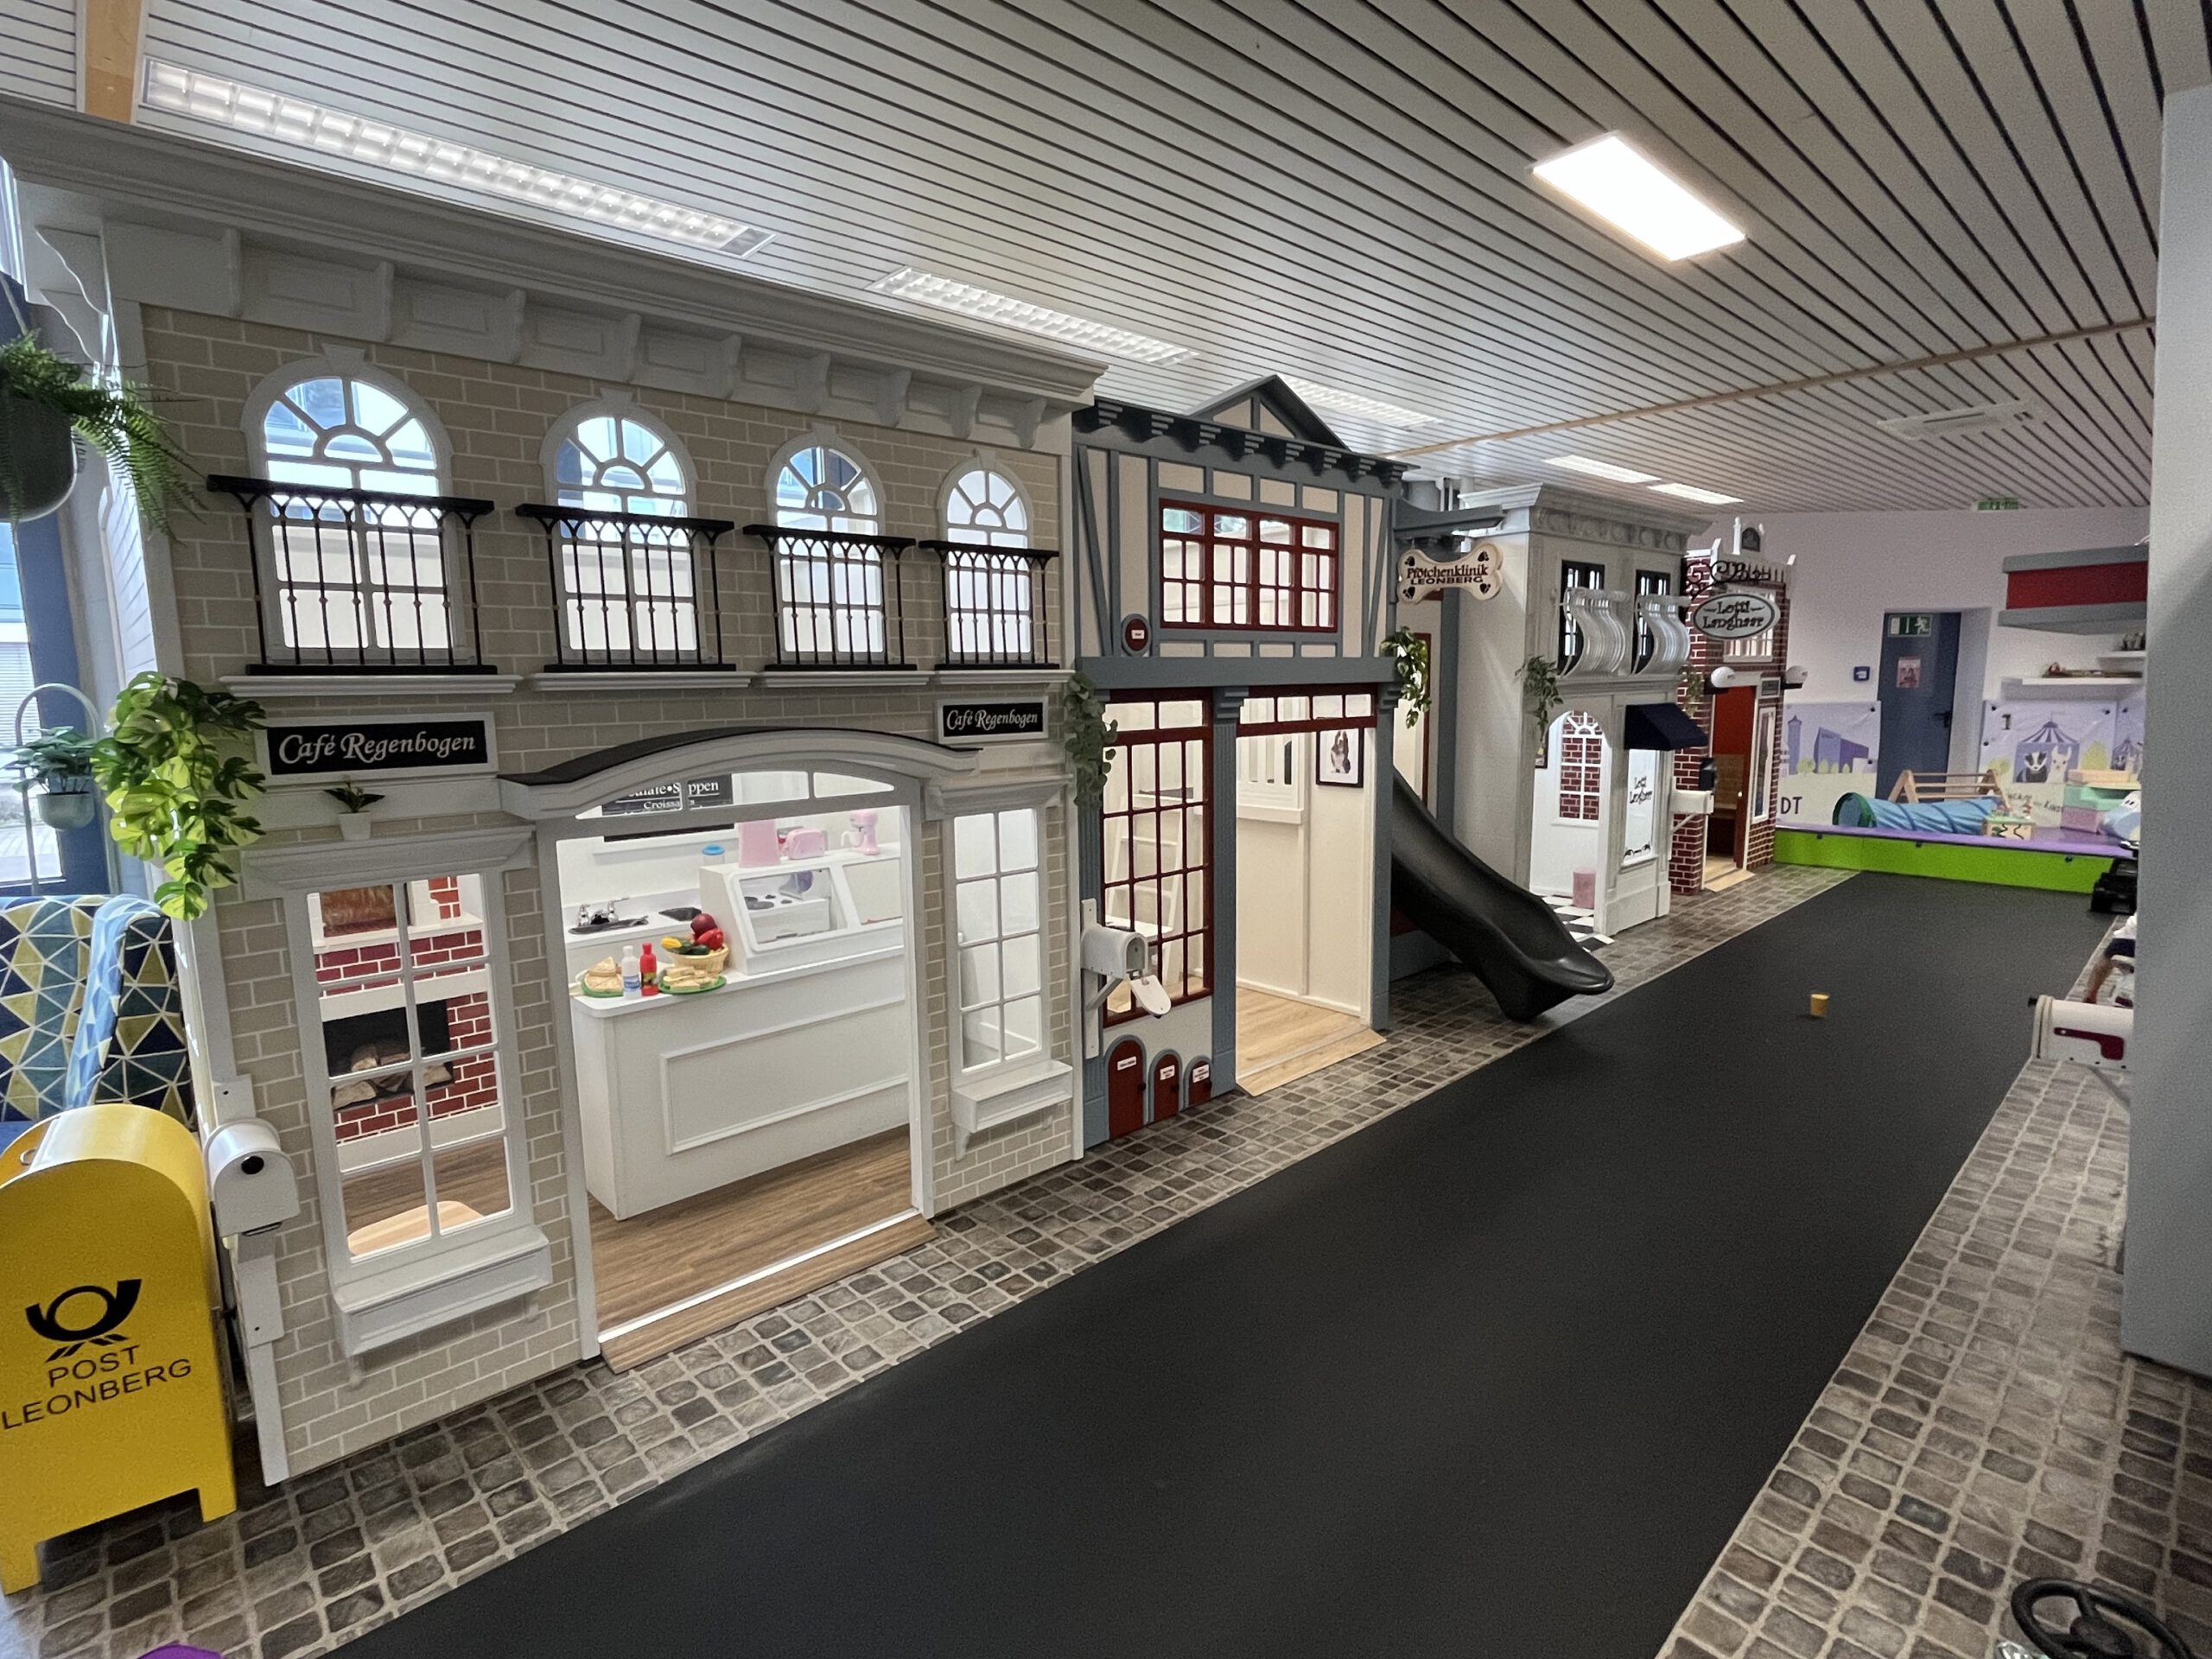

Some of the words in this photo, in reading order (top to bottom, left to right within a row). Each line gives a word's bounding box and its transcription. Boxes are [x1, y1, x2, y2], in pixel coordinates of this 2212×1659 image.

[1410, 575, 1484, 585] LEONBERG
[946, 709, 973, 731] Café
[975, 709, 1039, 731] Regenbogen
[278, 734, 336, 765] Café
[340, 731, 476, 764] Regenbogen
[48, 1344, 140, 1388] POST
[1, 1358, 192, 1430] LEONBERG
